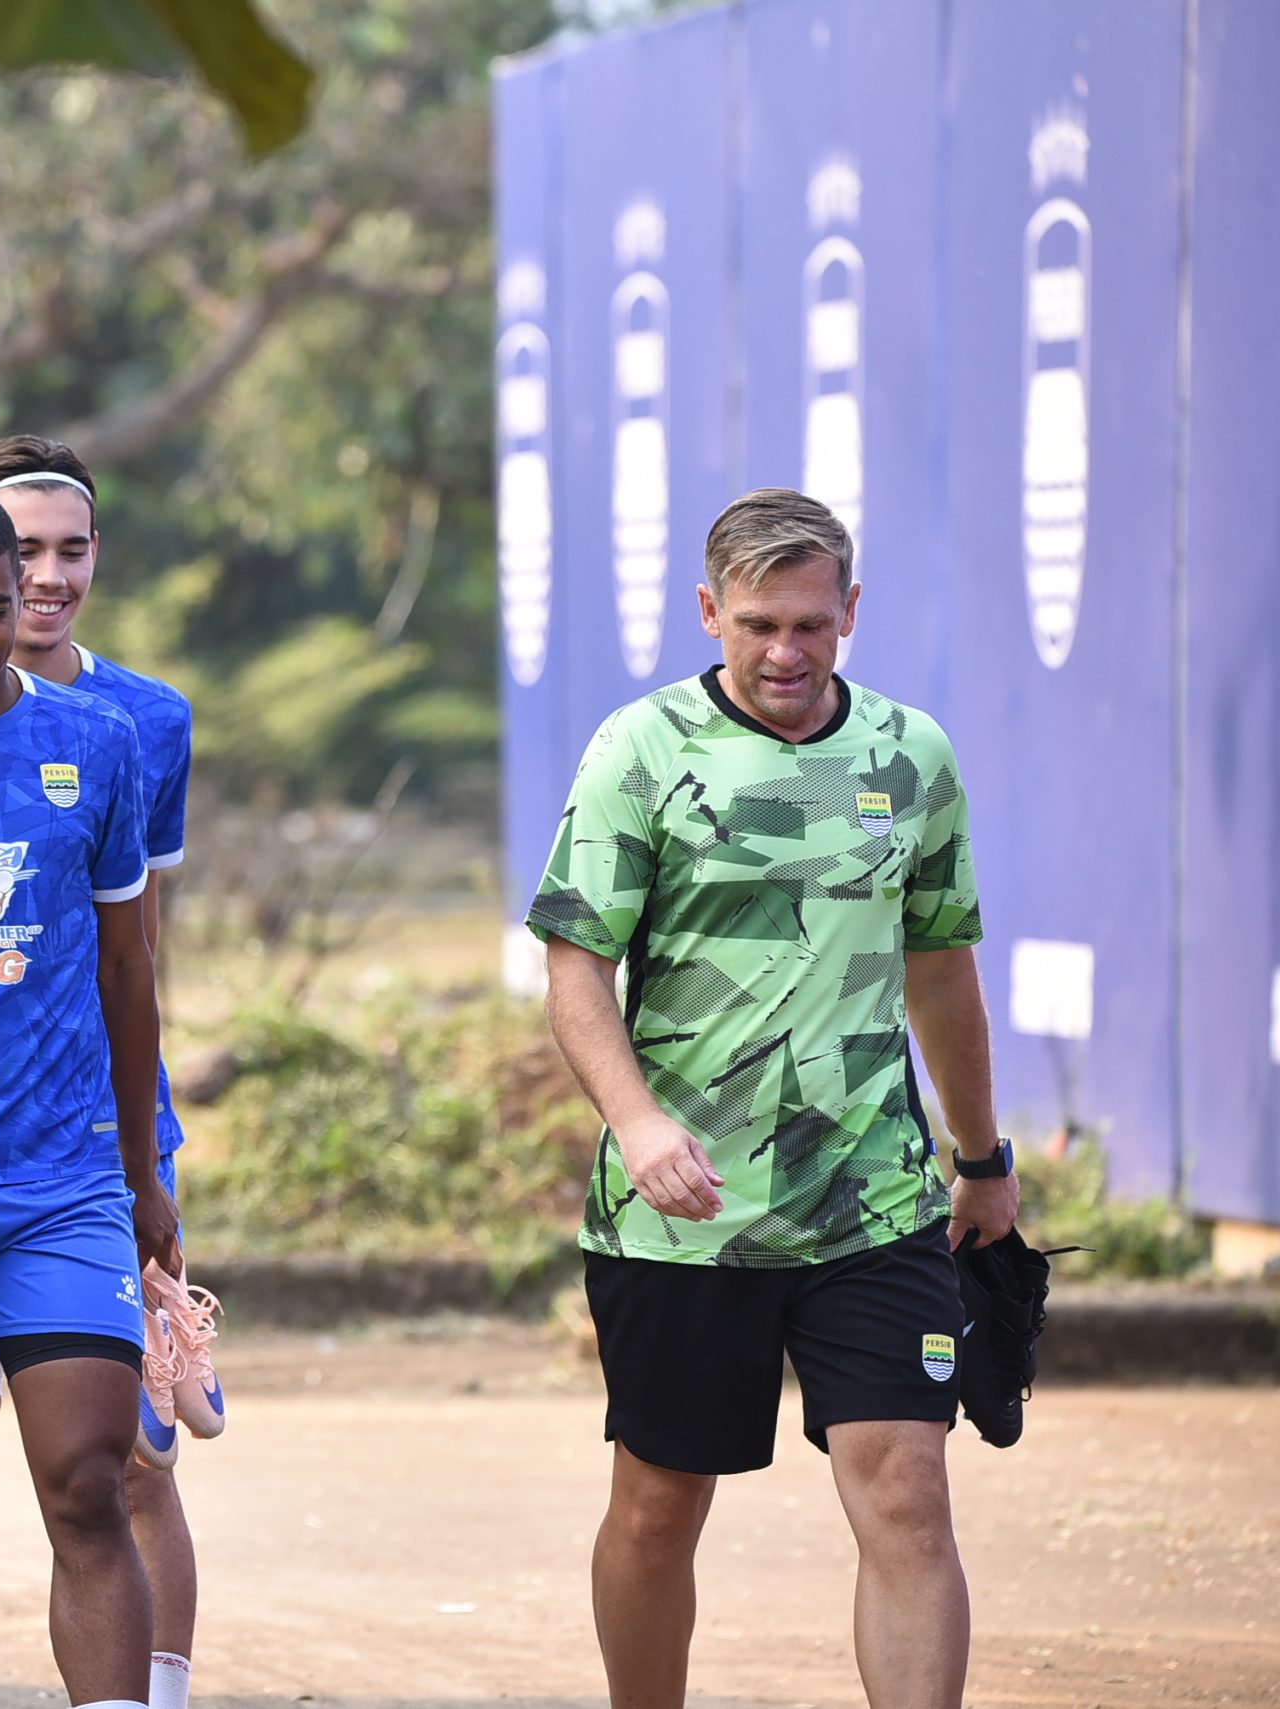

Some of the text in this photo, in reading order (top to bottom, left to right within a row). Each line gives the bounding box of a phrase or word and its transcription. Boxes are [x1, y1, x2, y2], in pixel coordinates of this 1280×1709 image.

[44, 769, 75, 777] PERSIB
[858, 797, 887, 805] PERSIB
[925, 1339, 951, 1349] PERSIB
